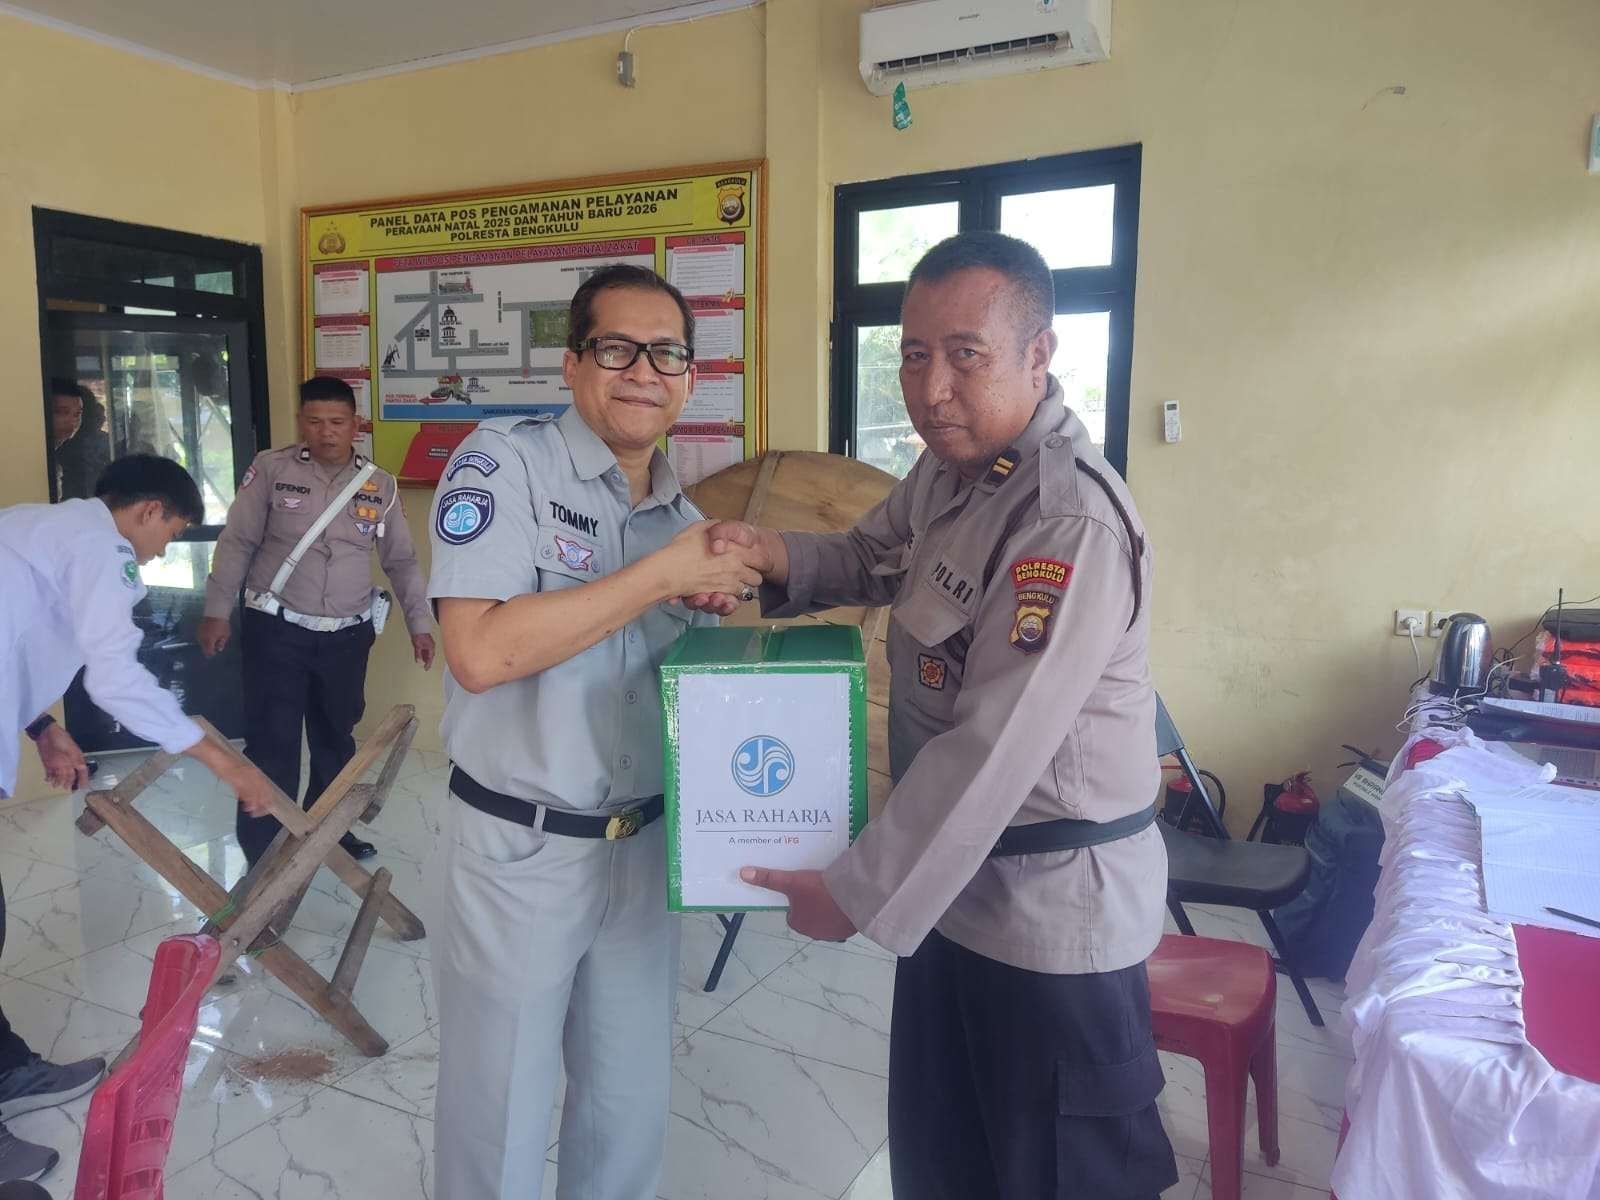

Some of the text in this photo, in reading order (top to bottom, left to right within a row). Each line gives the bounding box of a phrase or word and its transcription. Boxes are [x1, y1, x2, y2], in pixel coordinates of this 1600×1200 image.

[370, 188, 678, 228] PANEL DATA POS PENGAMANAN PELAYANAN
[385, 203, 657, 236] PERAYAAN NATAL 2025 DAN TAHUN BARU 2026
[451, 222, 579, 242] POLRESTA BENGKULU
[275, 482, 311, 495] EFENDI
[442, 493, 488, 508] JASA RAHARJA
[549, 501, 599, 537] TOMMY
[1016, 562, 1066, 576] POLRESTA
[1017, 570, 1064, 583] BENGKULU
[1018, 592, 1056, 604] BENGKULU
[695, 808, 832, 825] JASA RAHARJA
[728, 836, 736, 845] A
[738, 836, 771, 845] member
[773, 836, 782, 845] of
